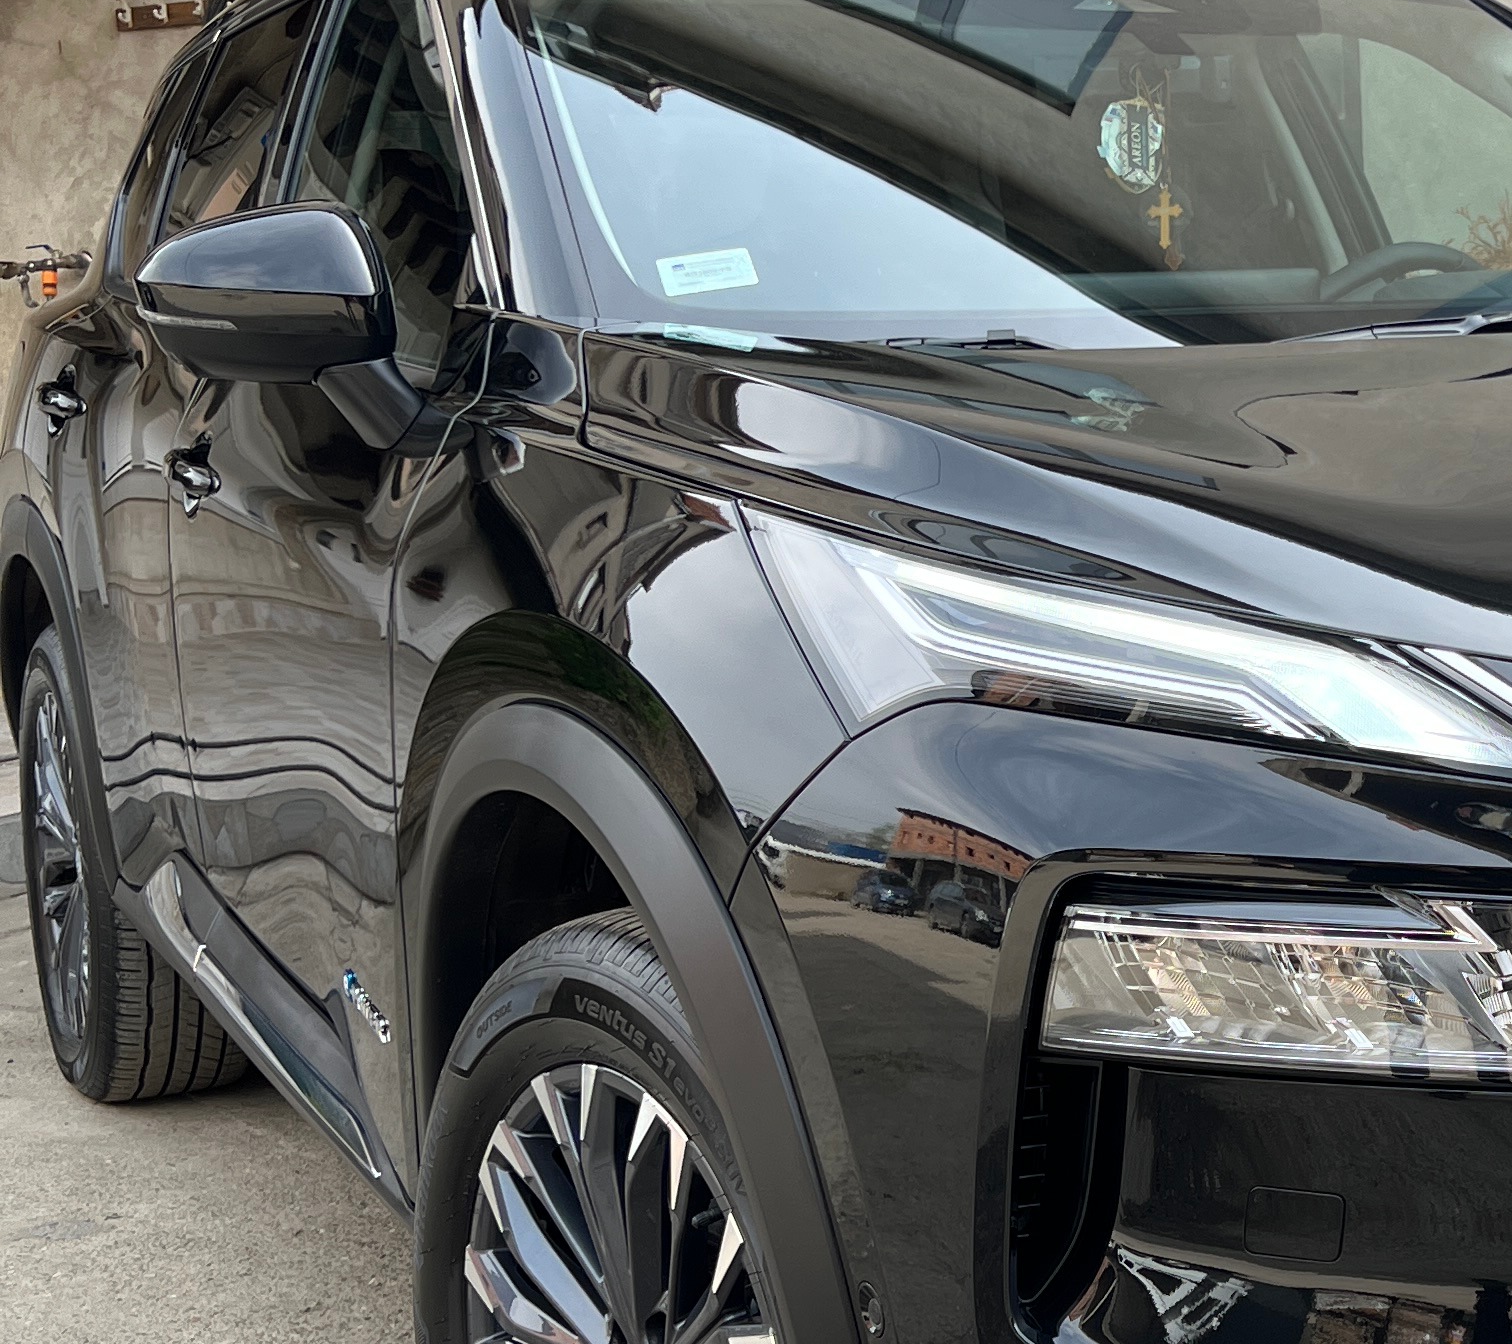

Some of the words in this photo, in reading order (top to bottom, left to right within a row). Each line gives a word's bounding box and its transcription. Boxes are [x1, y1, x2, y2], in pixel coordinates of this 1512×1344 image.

[1130, 121, 1142, 166] AREON
[476, 1000, 513, 1039] OUTSIDE
[648, 1042, 677, 1077] S1
